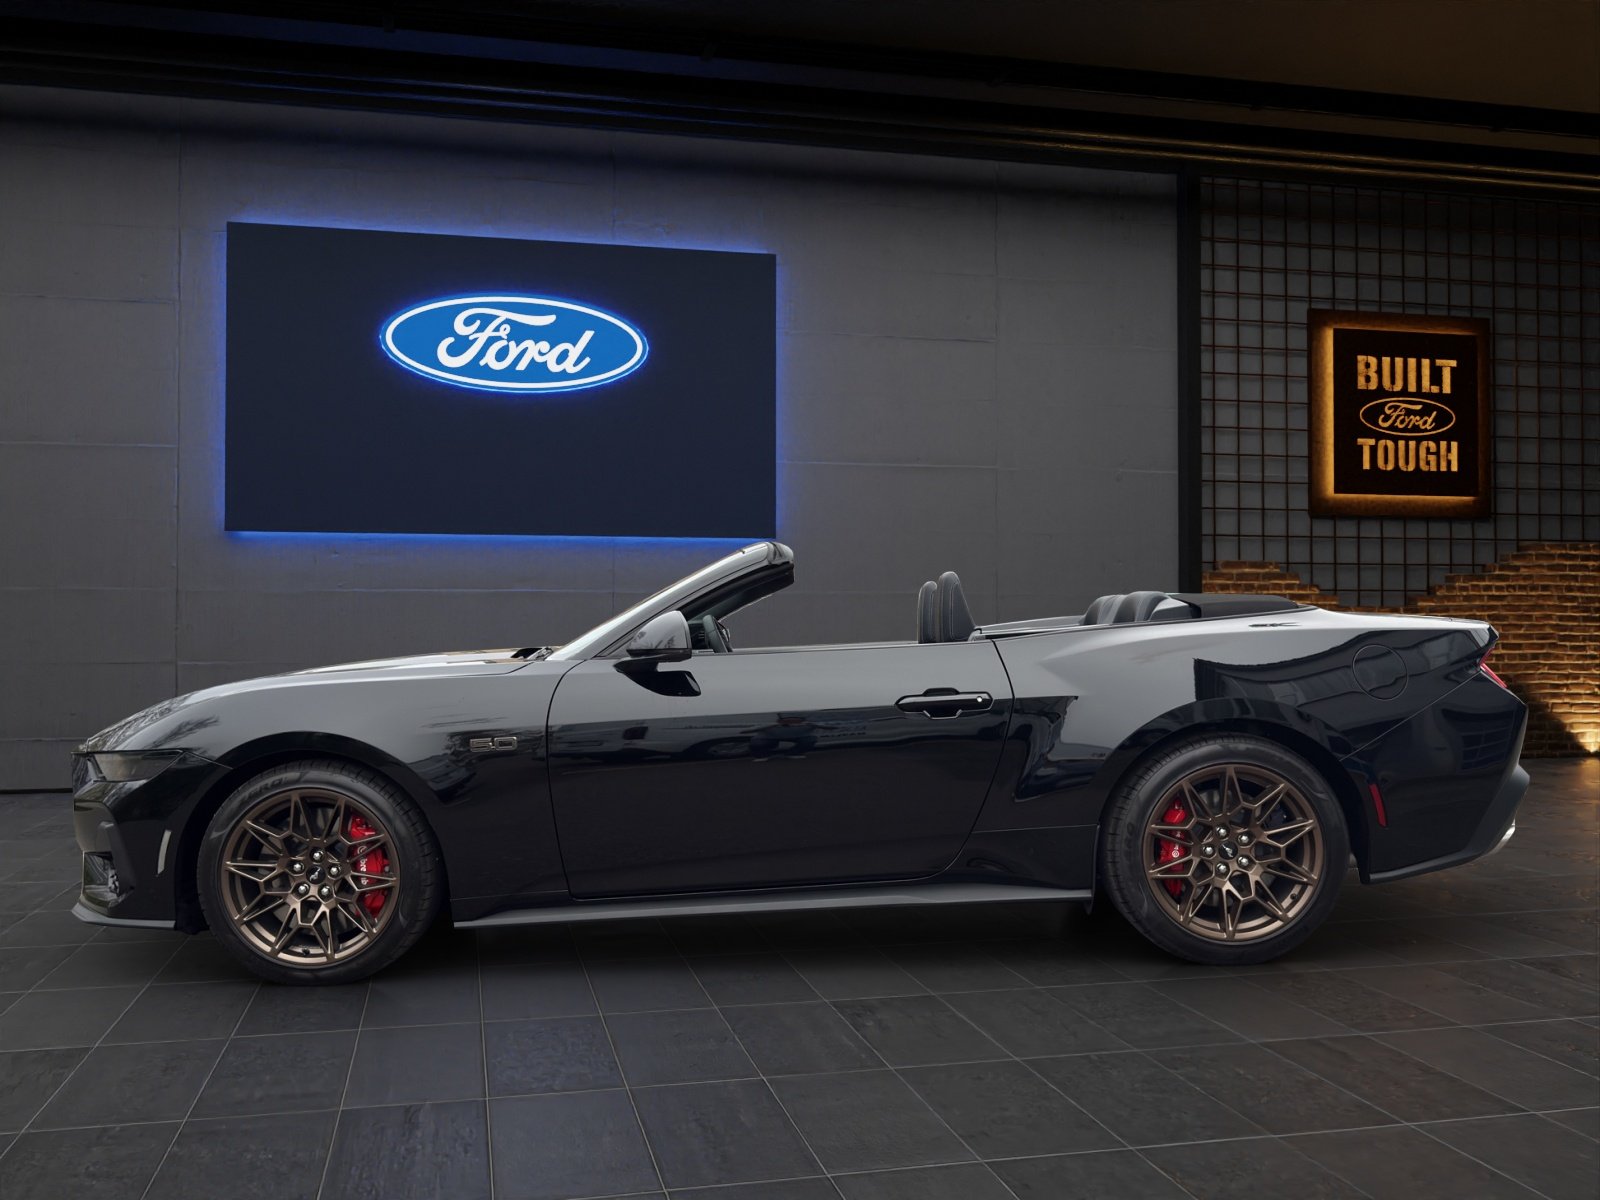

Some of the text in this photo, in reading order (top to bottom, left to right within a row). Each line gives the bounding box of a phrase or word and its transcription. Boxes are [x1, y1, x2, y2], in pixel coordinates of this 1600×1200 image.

[436, 307, 595, 374] Ford
[1356, 355, 1457, 394] BUILT
[1379, 402, 1437, 430] Ford
[1356, 437, 1459, 472] TOUGH
[469, 736, 518, 753] 5.0
